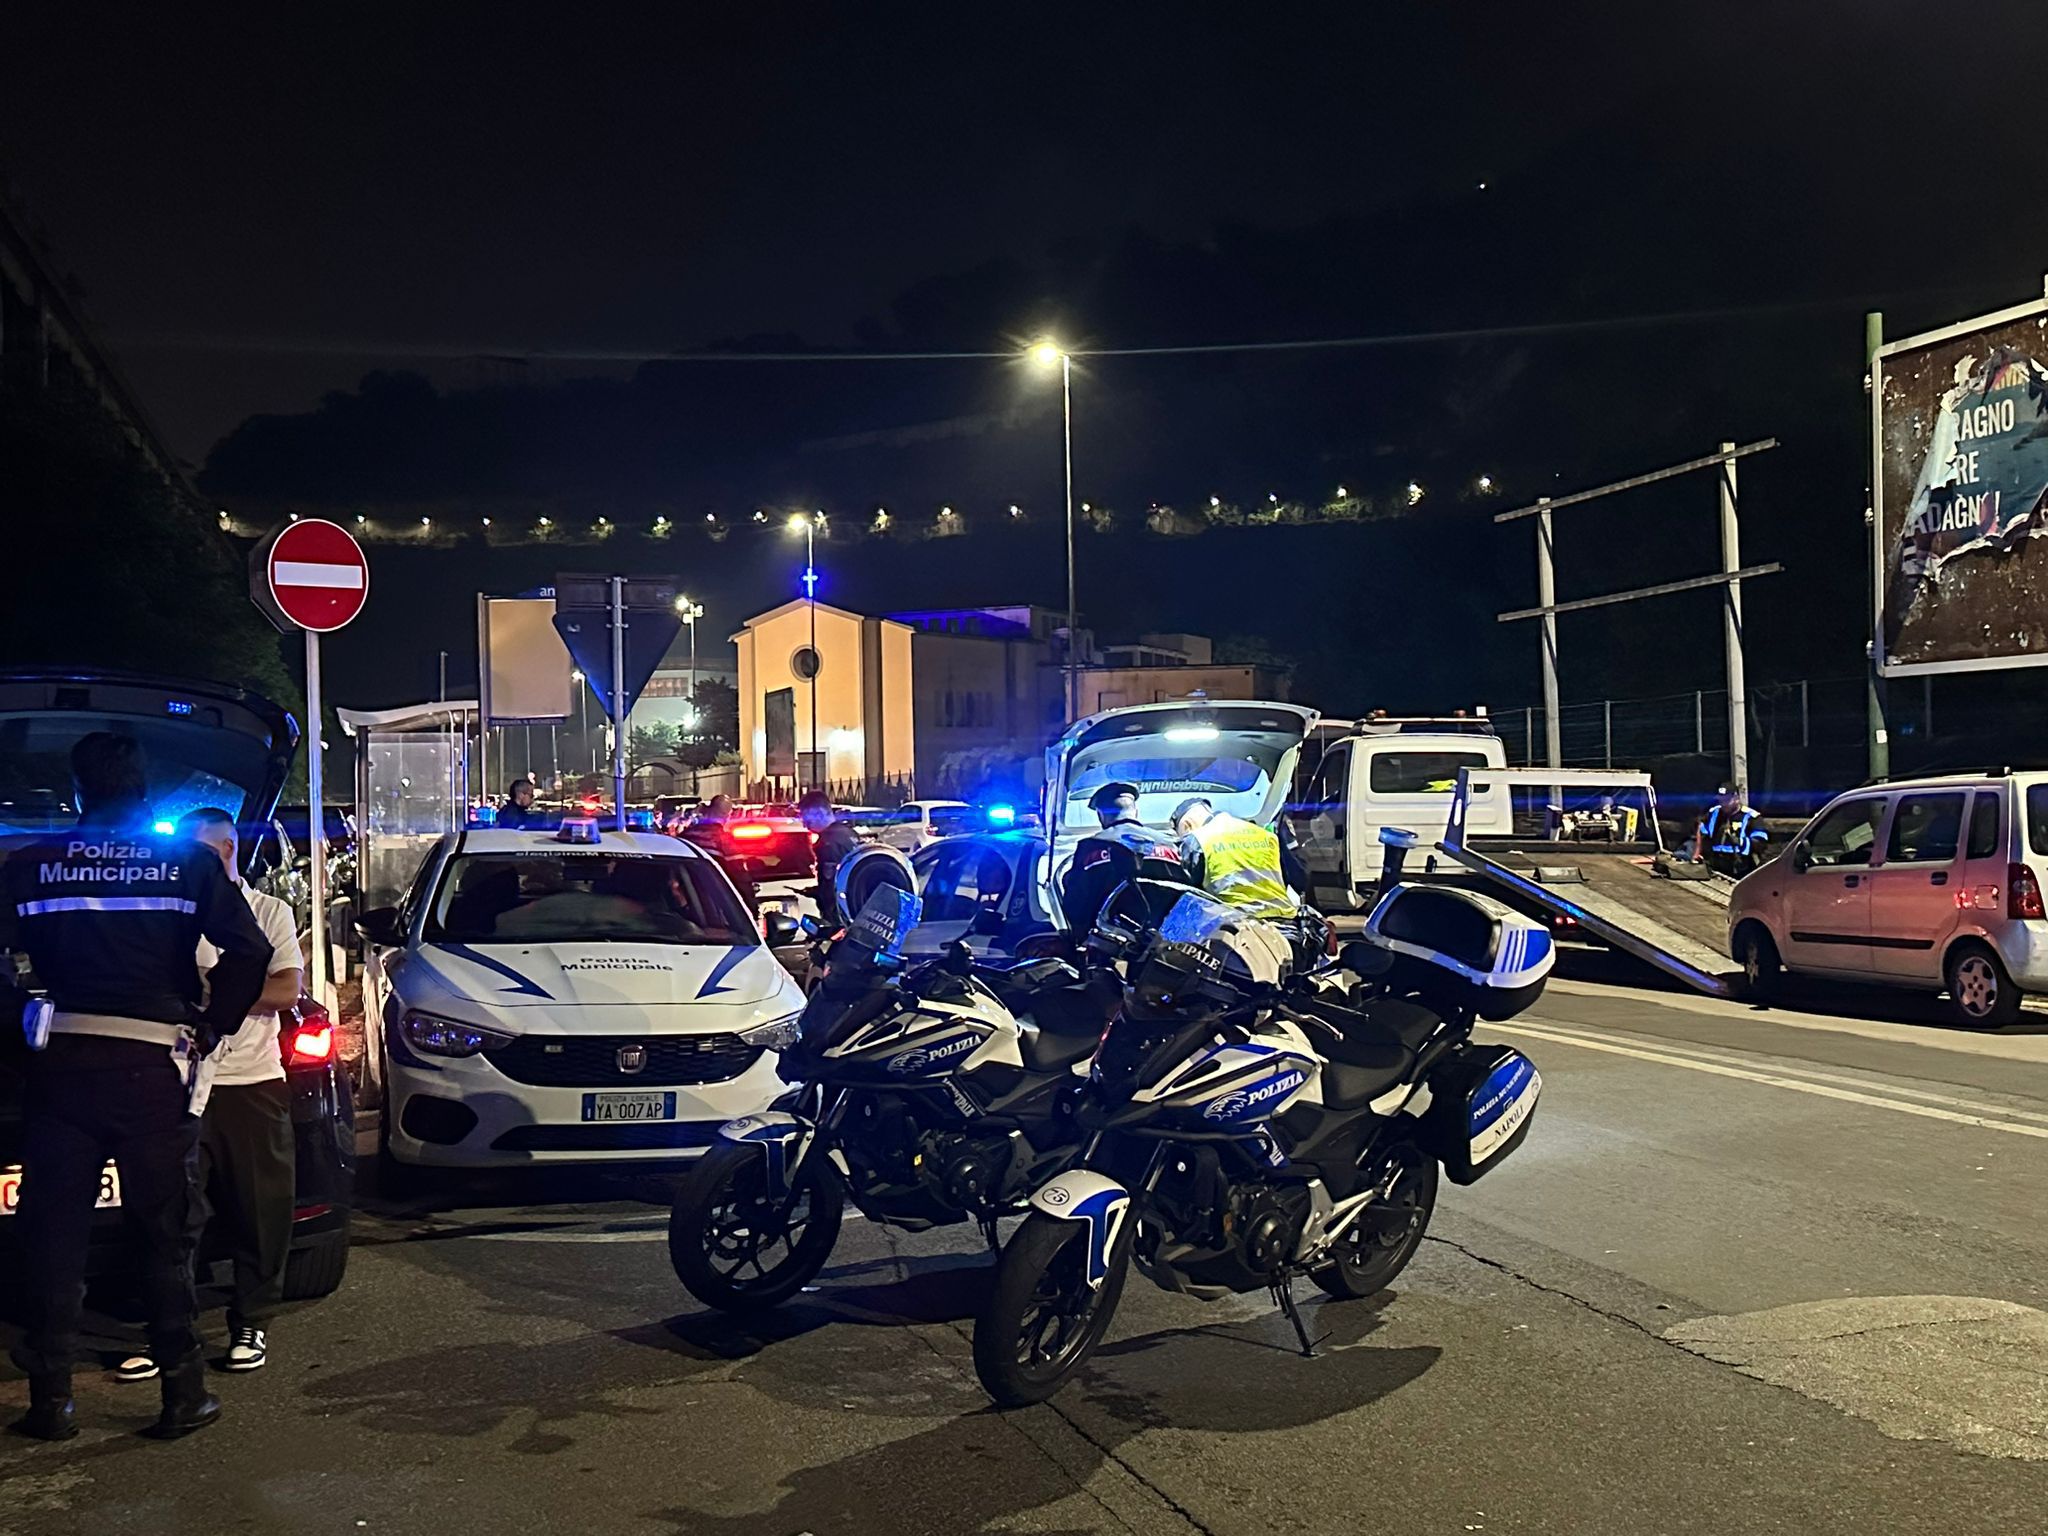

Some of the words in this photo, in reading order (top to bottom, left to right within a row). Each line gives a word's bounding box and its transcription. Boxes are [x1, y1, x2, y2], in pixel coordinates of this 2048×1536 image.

[66, 840, 152, 859] Polizia
[39, 861, 180, 885] Municipale
[560, 962, 674, 972] Municipale
[928, 1034, 982, 1062] POLIZIA
[1247, 1071, 1304, 1105] POLIZIA
[596, 1103, 613, 1119] YA
[1473, 1095, 1500, 1120] POLIZIA
[1494, 1105, 1525, 1138] NAPOLI
[1046, 1188, 1067, 1203] 75
